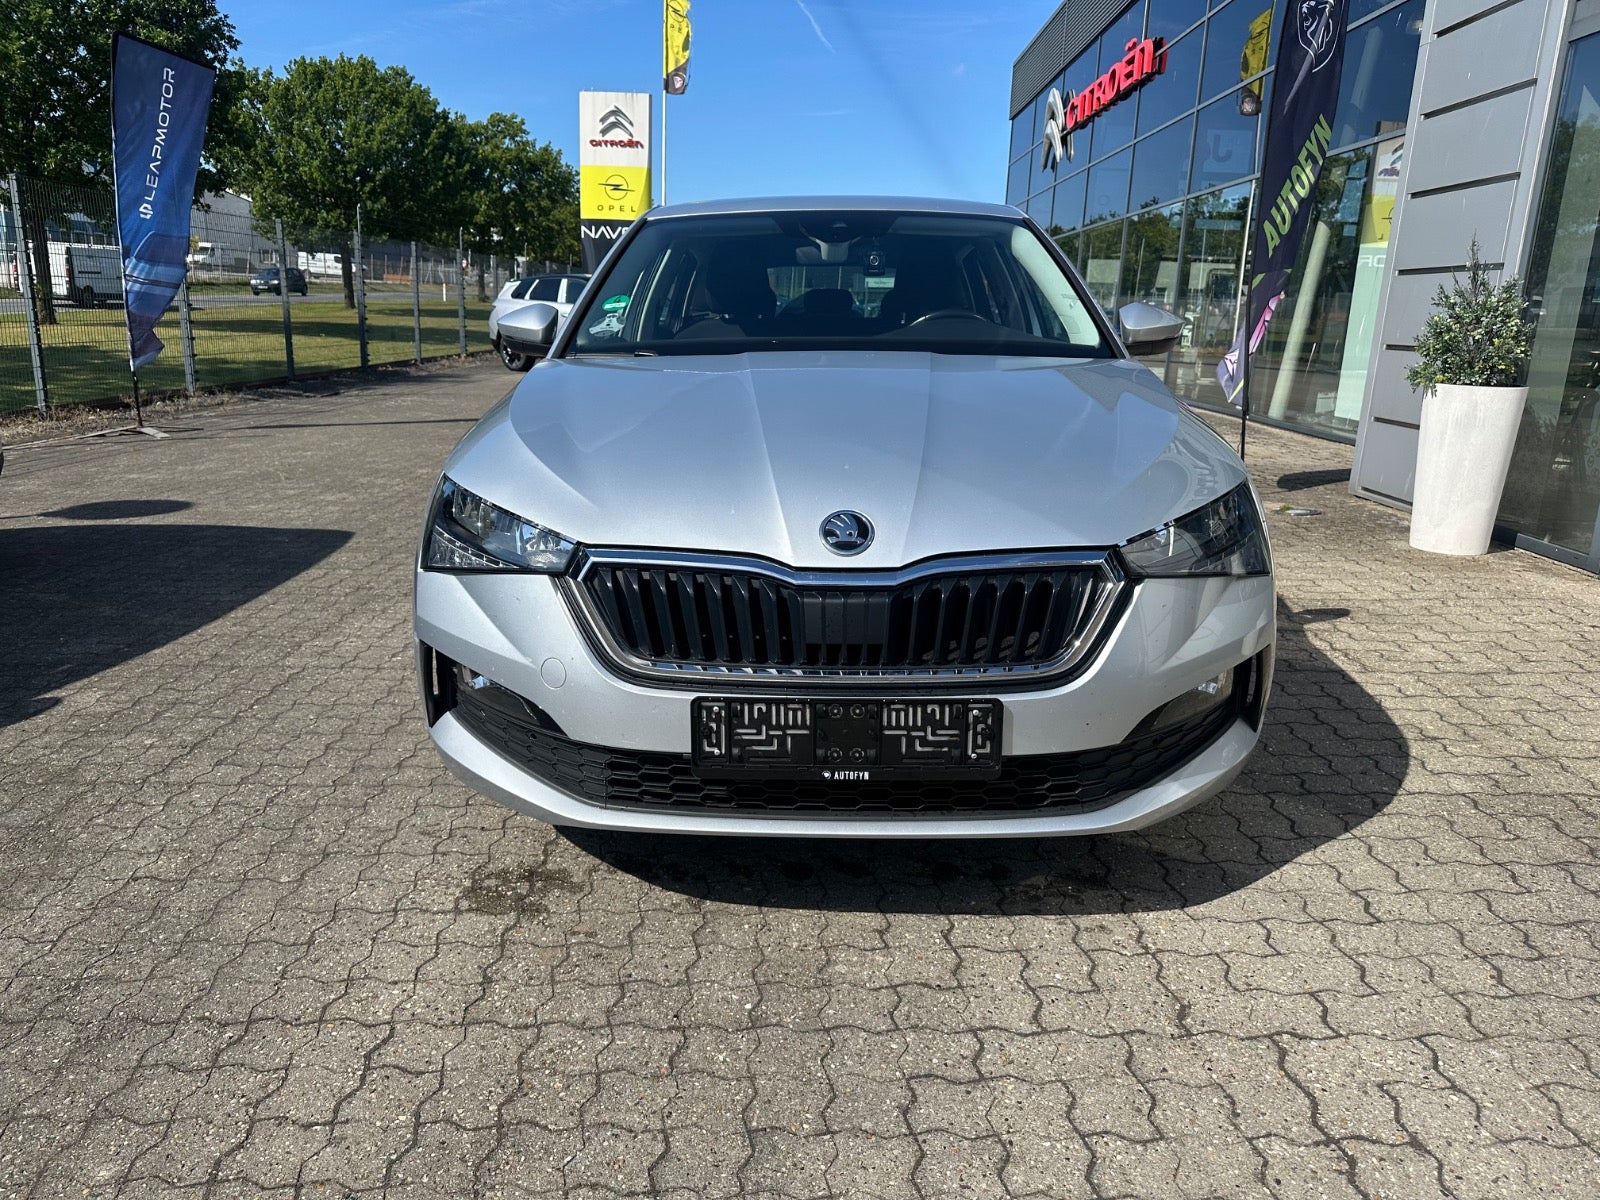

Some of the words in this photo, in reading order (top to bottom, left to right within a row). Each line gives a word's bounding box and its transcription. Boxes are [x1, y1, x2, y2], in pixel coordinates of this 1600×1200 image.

[144, 67, 175, 201] LEAPMOTOR
[597, 204, 636, 213] OPEL
[1263, 113, 1332, 259] AUTOFYN
[833, 771, 869, 780] AUTOFYN
